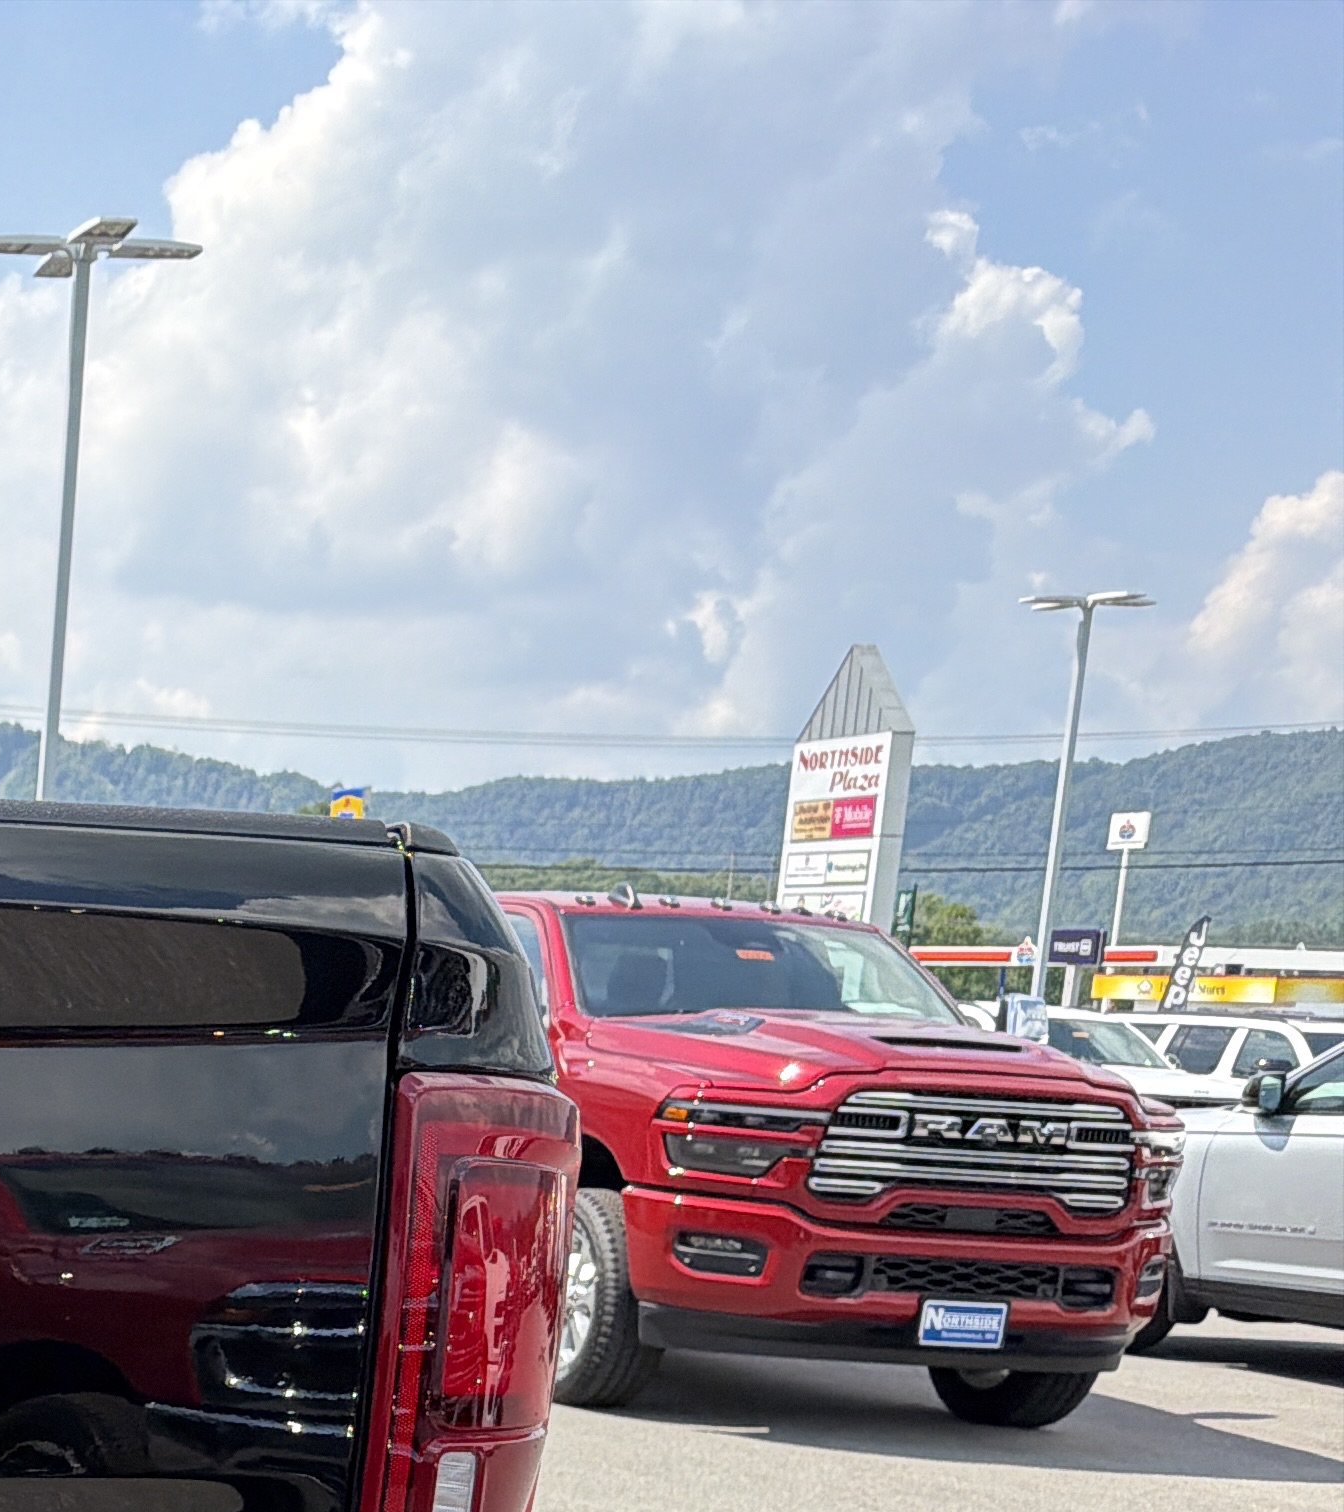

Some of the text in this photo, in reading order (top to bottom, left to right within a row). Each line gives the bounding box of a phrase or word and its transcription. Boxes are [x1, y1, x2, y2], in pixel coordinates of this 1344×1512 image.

[798, 744, 884, 772] NORTHSIDE
[829, 770, 881, 793] Plaza
[1163, 920, 1209, 1009] Jeep
[911, 1113, 1069, 1146] RAM
[924, 1306, 1002, 1331] NORTHSIDE
